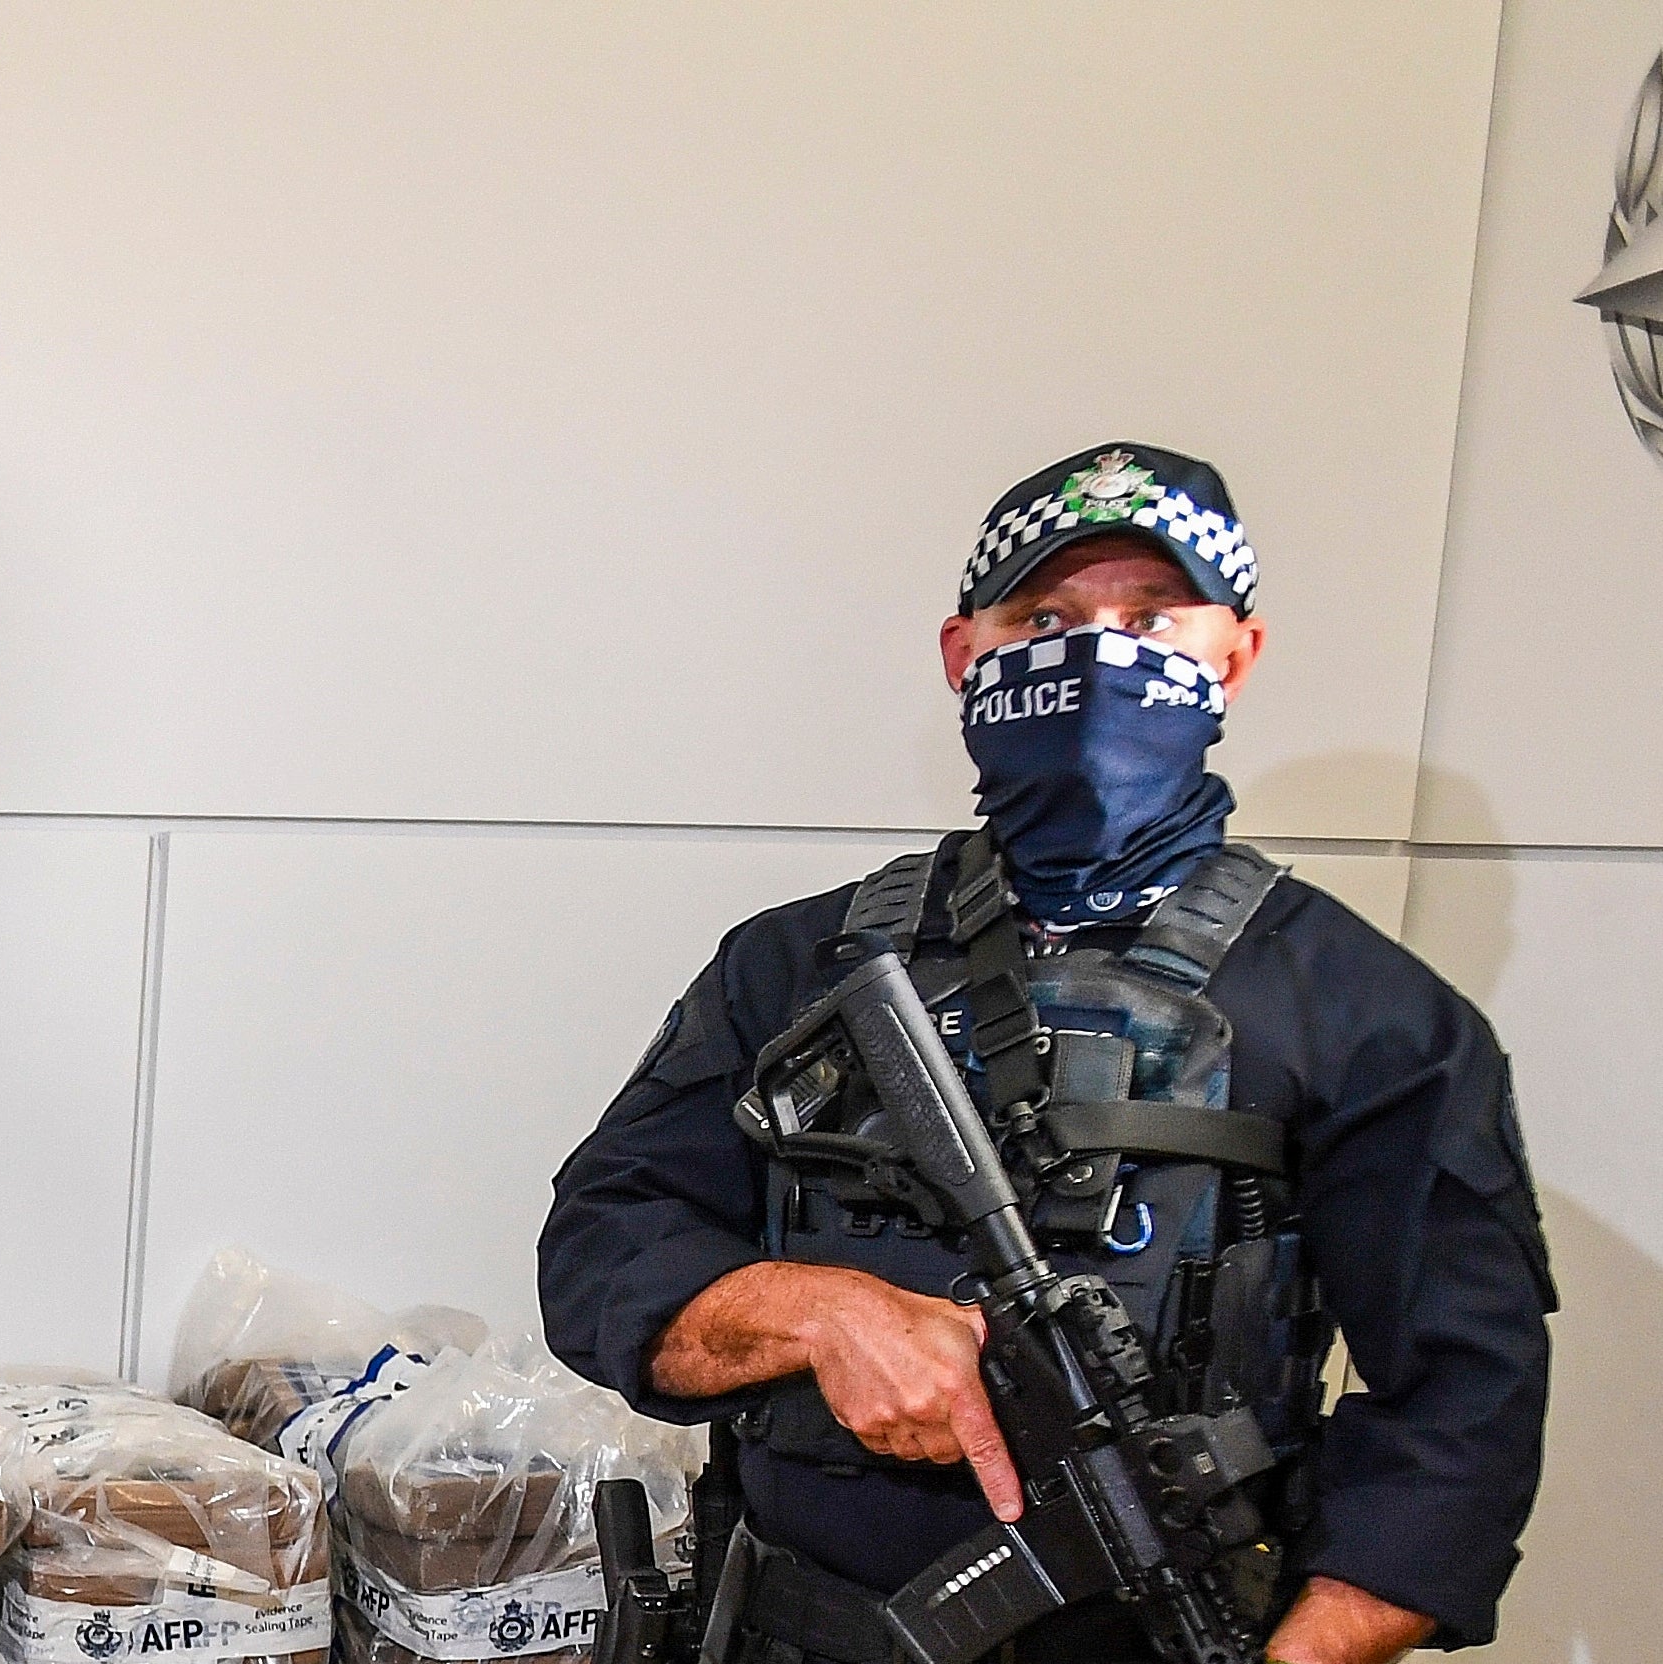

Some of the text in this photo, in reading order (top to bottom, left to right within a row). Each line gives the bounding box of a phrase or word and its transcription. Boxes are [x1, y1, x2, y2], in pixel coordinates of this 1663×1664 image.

[970, 677, 1083, 727] POLICE
[244, 1615, 314, 1636] Sealing Tape
[254, 1602, 303, 1620] Evidence
[540, 1609, 599, 1640] AFP
[140, 1619, 204, 1653] AFP
